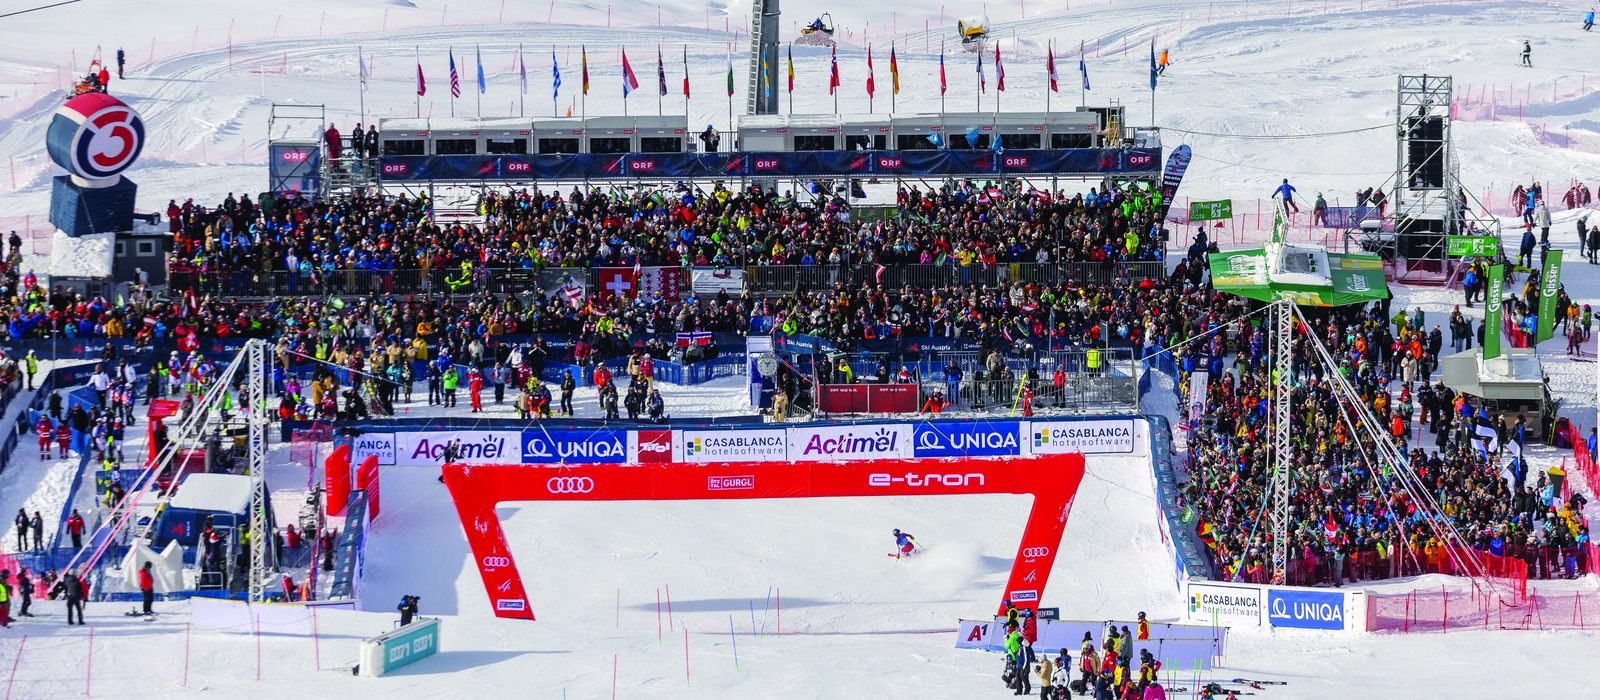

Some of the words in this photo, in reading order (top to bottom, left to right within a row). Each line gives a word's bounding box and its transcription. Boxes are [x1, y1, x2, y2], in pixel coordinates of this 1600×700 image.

[1346, 273, 1370, 292] Gösser
[1543, 263, 1558, 297] Gösser
[1488, 278, 1501, 313] Gösser
[795, 341, 813, 349] Austria
[803, 427, 897, 455] Actimel
[950, 431, 1018, 449] UNIQA
[1053, 427, 1130, 439] CASABLANCA
[557, 440, 624, 458] UNIQA
[704, 437, 783, 447] CASABLANCA
[1053, 437, 1131, 447] hotelsoftware
[704, 446, 783, 456] hotelsoftware
[723, 478, 753, 487] GURGL
[868, 472, 985, 486] e-tron
[1202, 594, 1258, 608] CASABLANCA
[1293, 602, 1343, 622] UNIQA
[967, 623, 988, 641] A1
